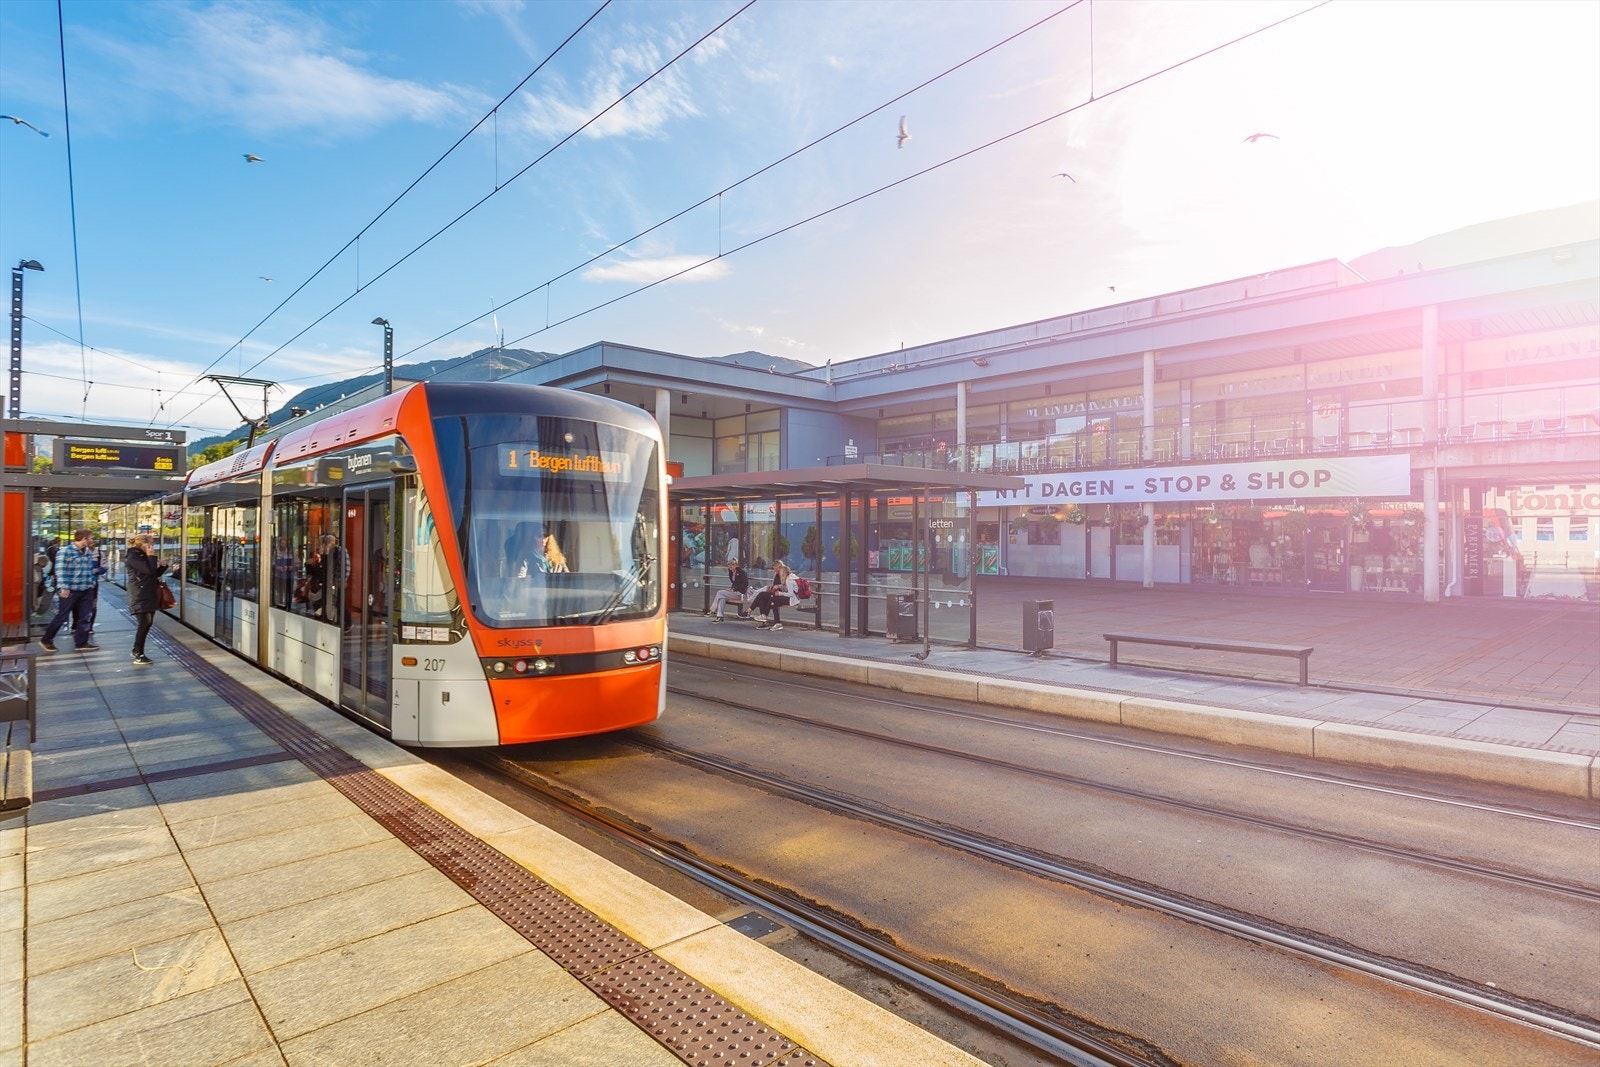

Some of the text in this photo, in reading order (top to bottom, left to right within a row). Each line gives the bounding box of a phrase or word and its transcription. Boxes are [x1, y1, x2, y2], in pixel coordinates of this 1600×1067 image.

[145, 430, 173, 440] Spor 1
[70, 446, 95, 454] Bergen
[70, 452, 95, 461] Bergen
[347, 454, 372, 472] bybanen
[509, 450, 518, 468] 1
[529, 450, 573, 473] Bergen
[1041, 479, 1114, 497] DAGEN
[1144, 475, 1211, 494] STOP
[1220, 474, 1236, 491] &
[1247, 469, 1331, 490] SHOP
[1469, 524, 1478, 579] PARFYMERI
[497, 637, 533, 648] skyss
[424, 658, 446, 672] 207
